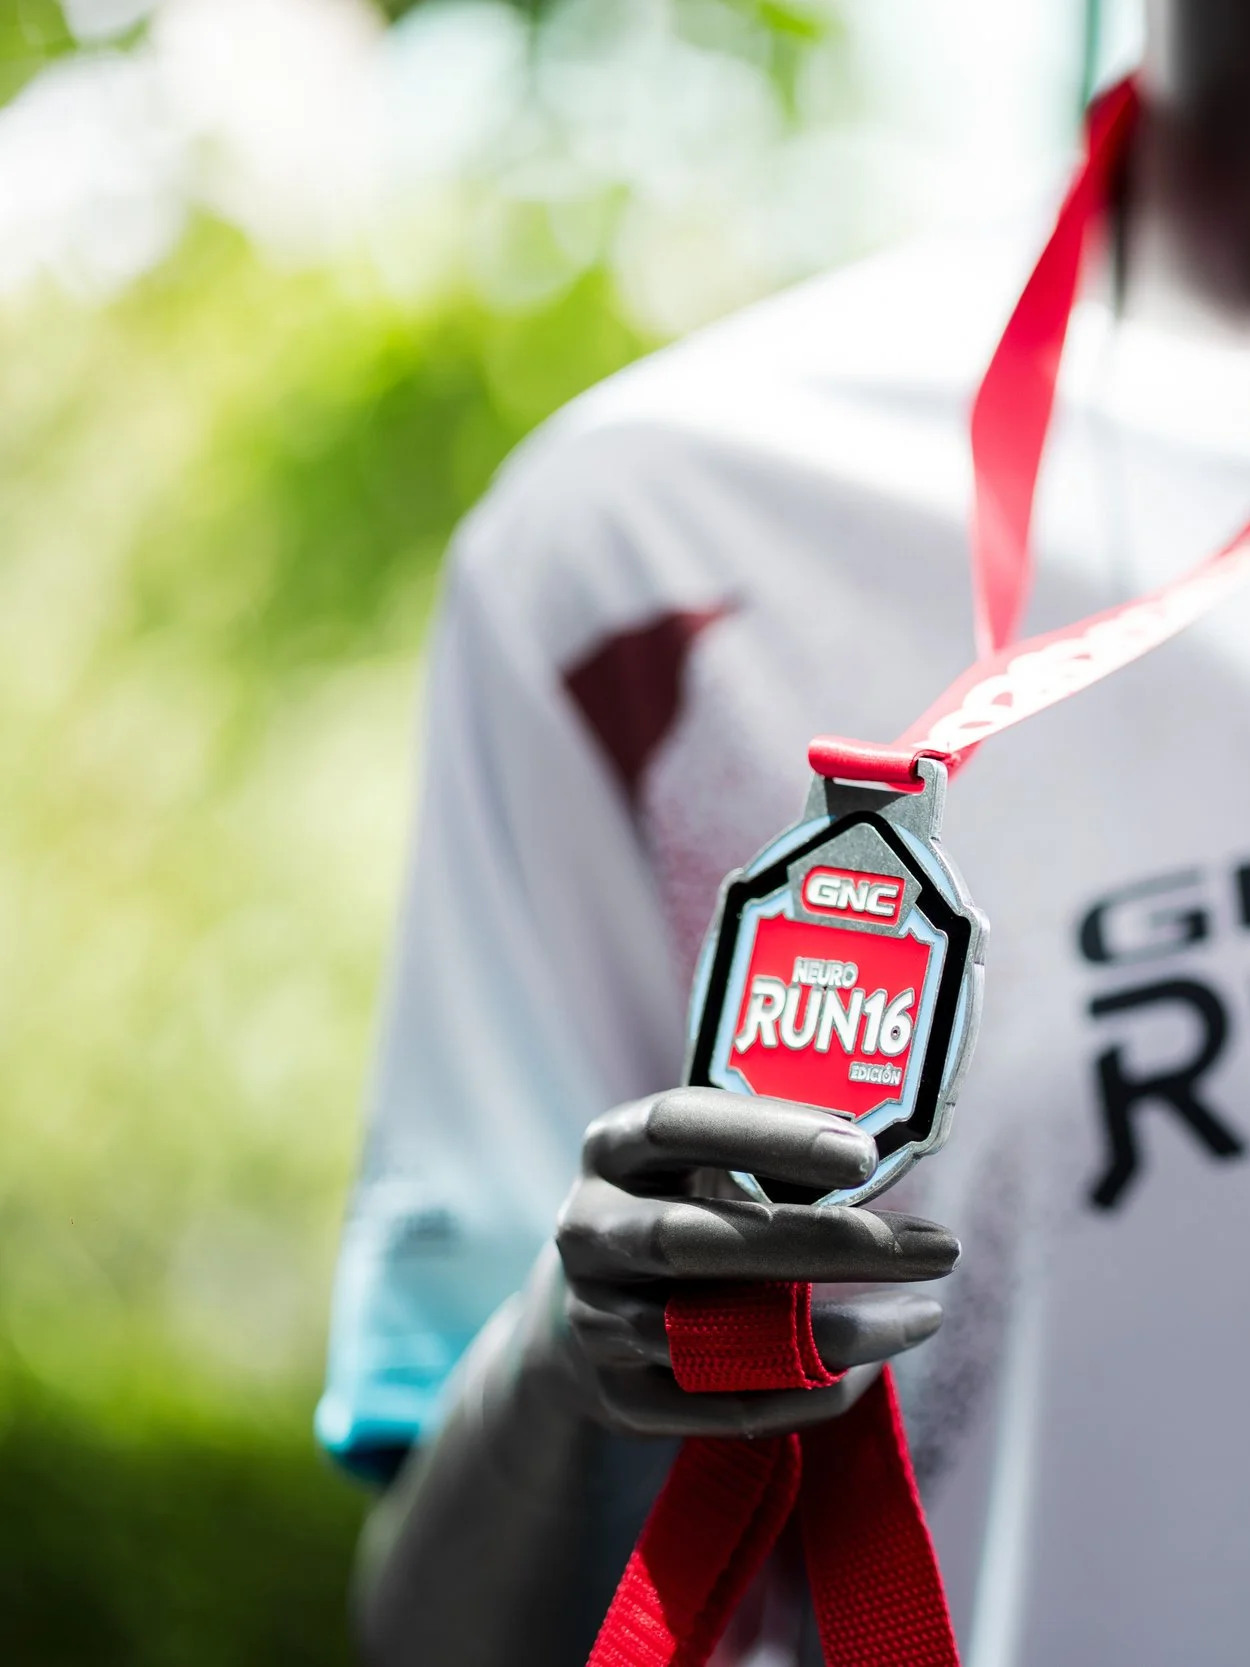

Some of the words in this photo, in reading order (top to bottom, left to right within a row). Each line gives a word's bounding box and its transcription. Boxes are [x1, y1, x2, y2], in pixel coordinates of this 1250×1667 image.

[806, 875, 899, 917] GNC
[793, 956, 859, 989] NEURO
[848, 1061, 902, 1086] EDICIÓN
